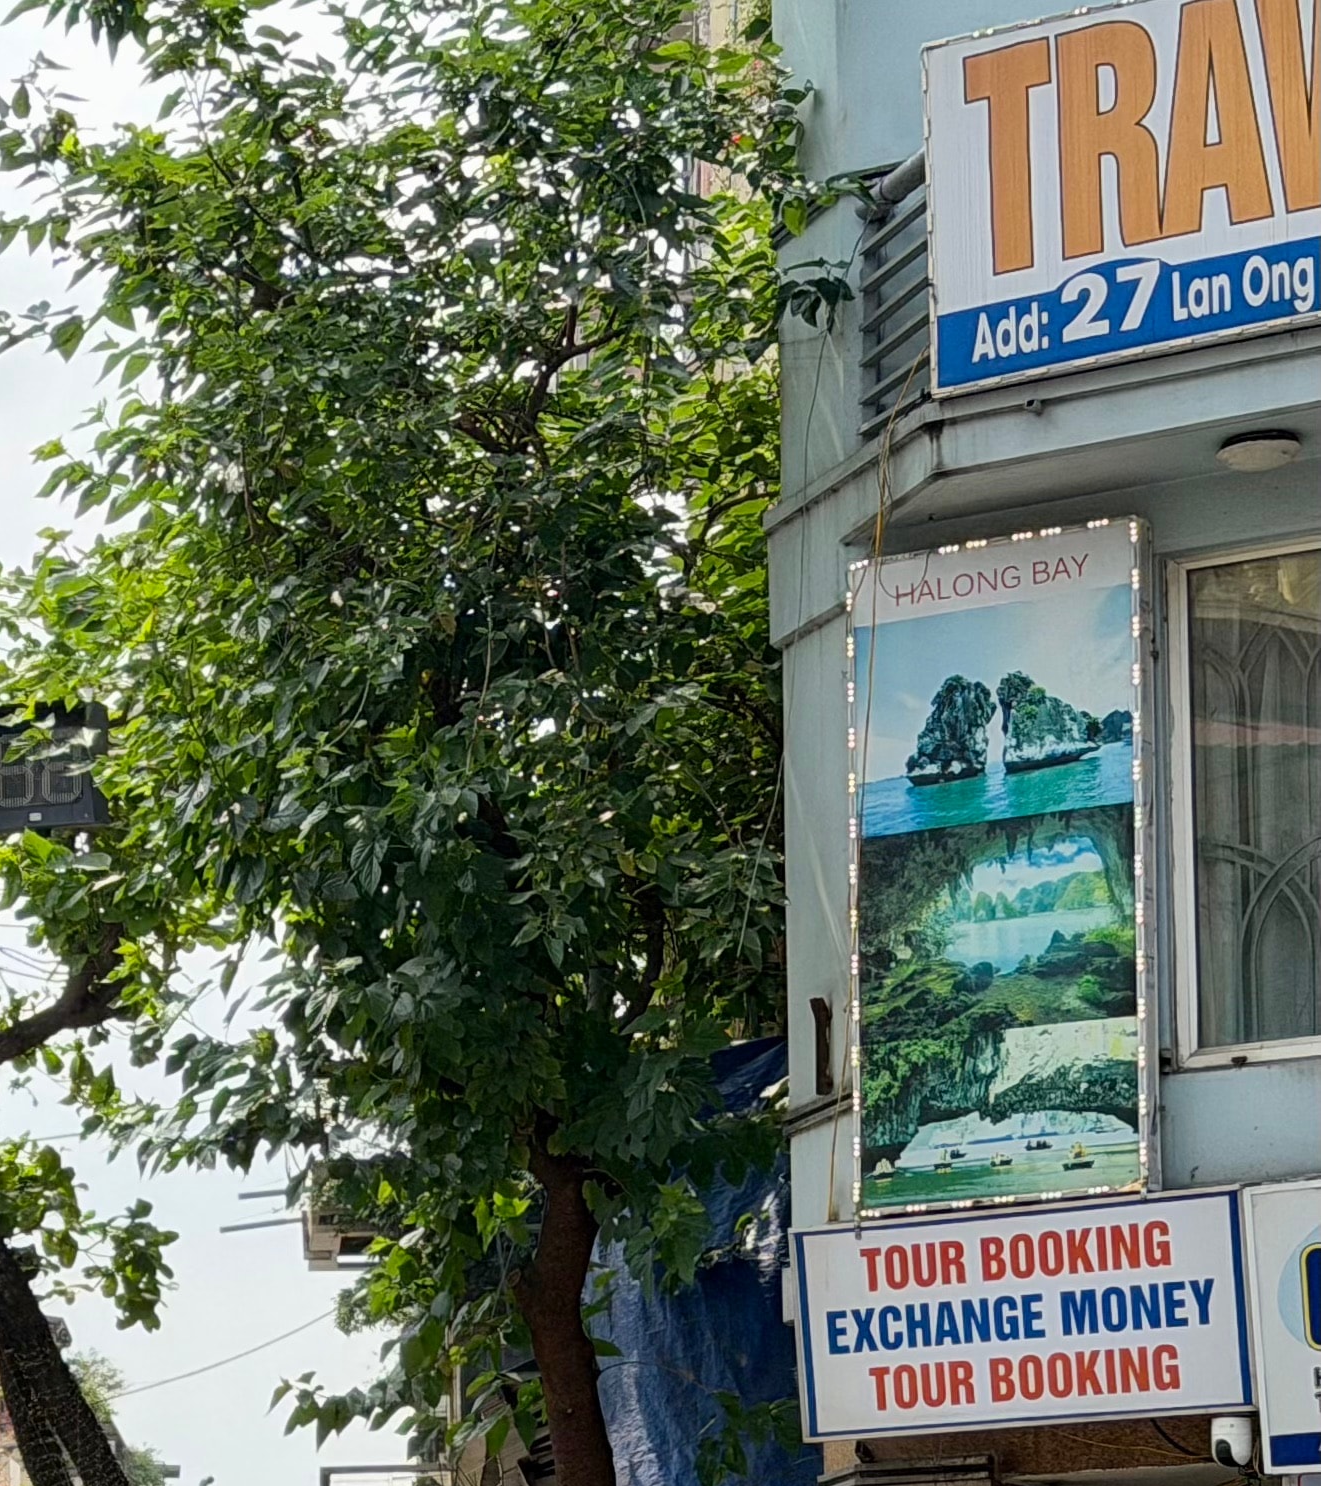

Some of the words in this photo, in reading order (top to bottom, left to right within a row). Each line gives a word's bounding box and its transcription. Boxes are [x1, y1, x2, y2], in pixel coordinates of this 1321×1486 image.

[972, 301, 1049, 364] Add:
[1060, 259, 1160, 345] 27
[1172, 270, 1231, 322] Lan
[1242, 254, 1315, 313] Ong
[1031, 552, 1090, 585] BAY
[860, 1239, 966, 1292] TOUR
[979, 1220, 1172, 1283] BOOKING
[826, 1293, 1046, 1356] EXCHANGE
[1060, 1278, 1215, 1337] MONEY
[869, 1359, 976, 1412] TOUR
[988, 1344, 1181, 1404] BOOKING
